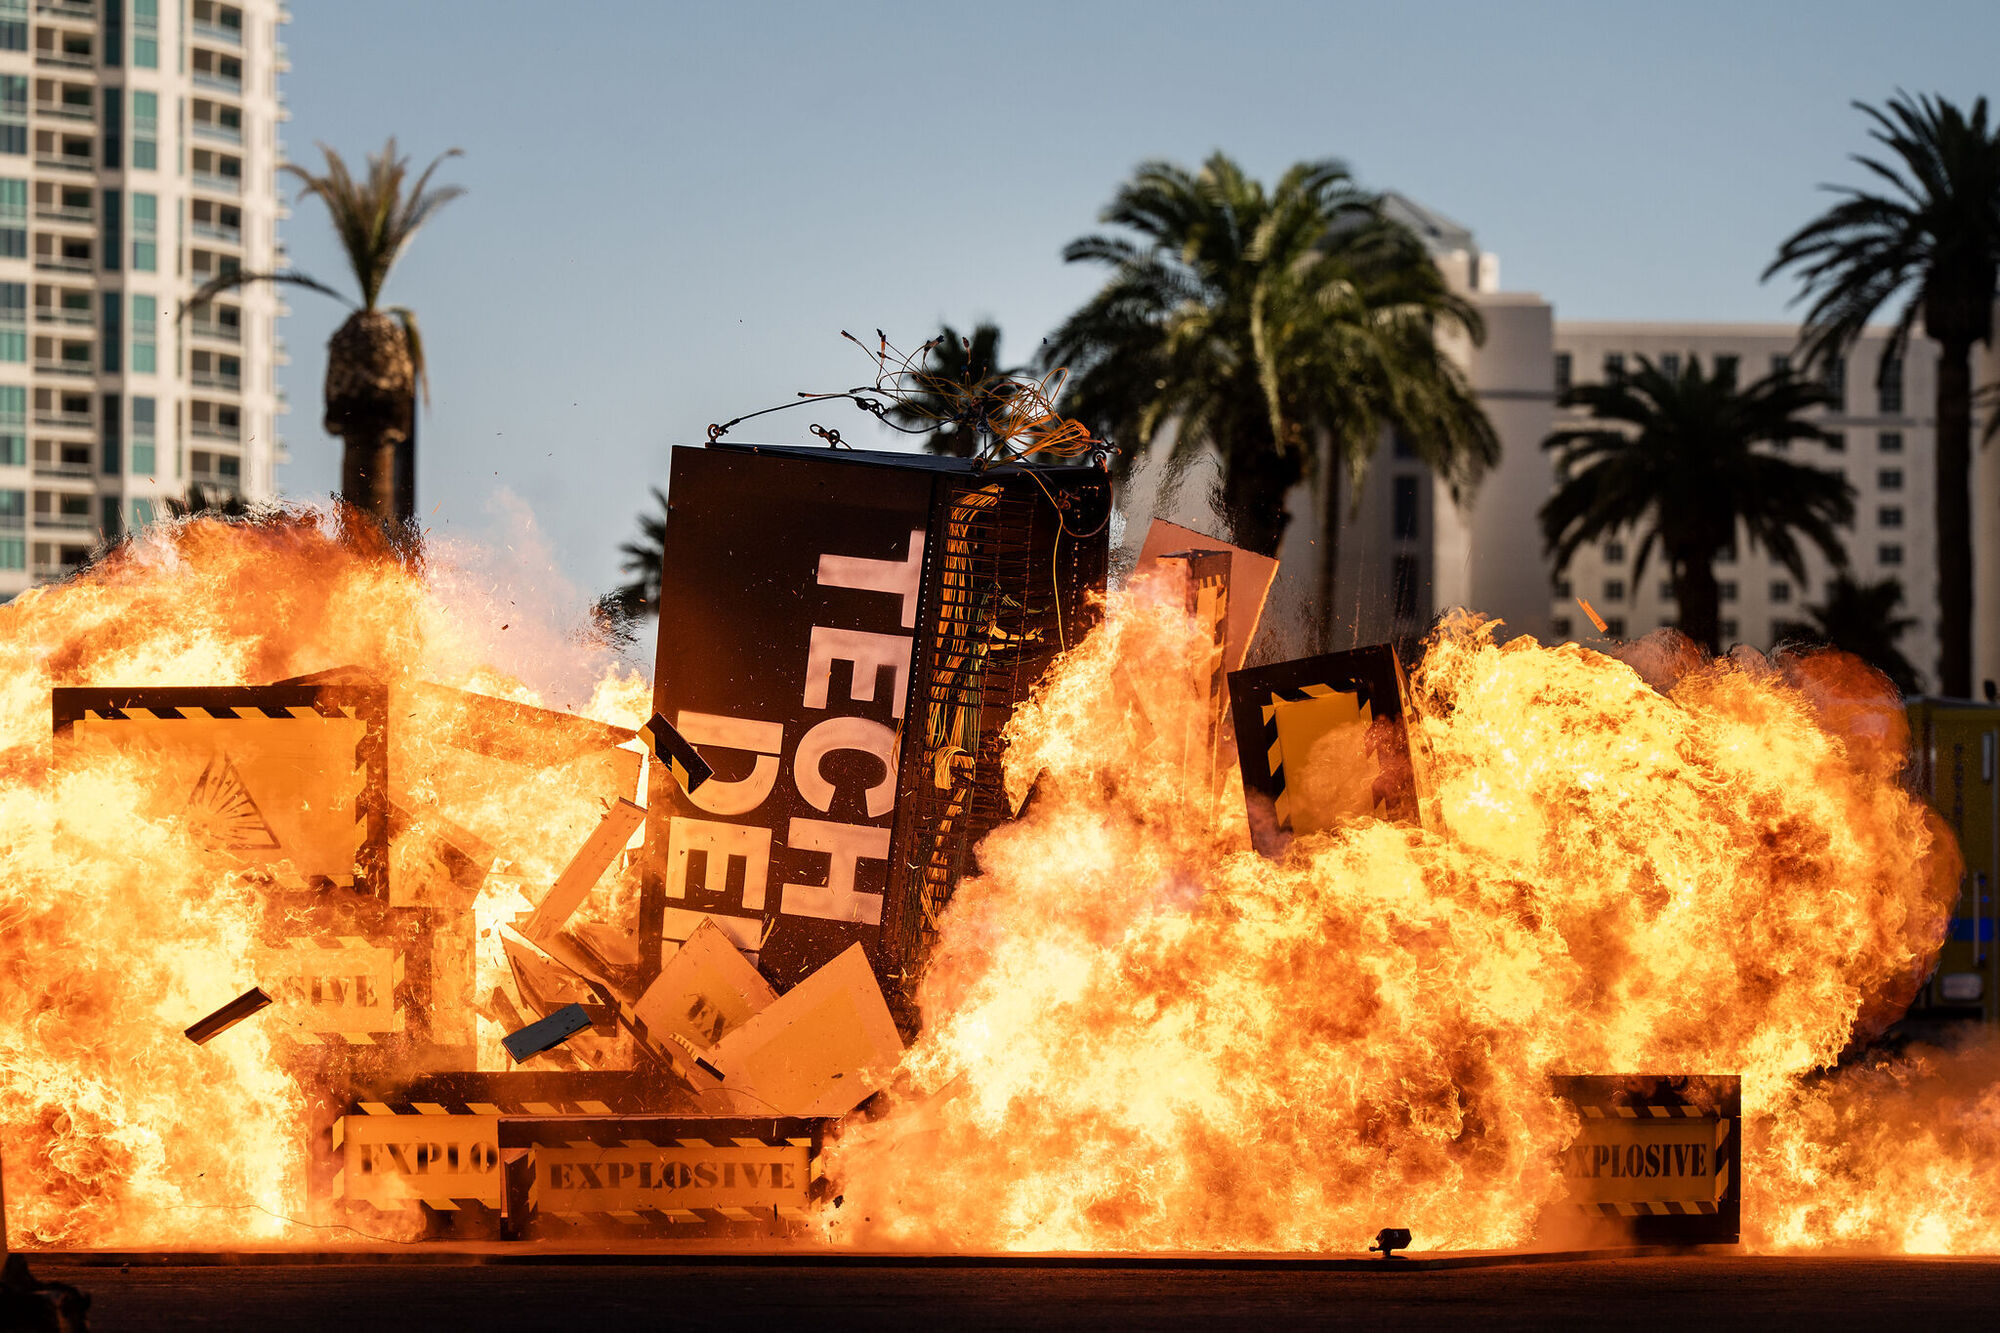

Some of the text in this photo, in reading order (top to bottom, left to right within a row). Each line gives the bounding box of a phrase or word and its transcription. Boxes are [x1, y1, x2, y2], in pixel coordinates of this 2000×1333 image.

[780, 530, 926, 926] TECH
[549, 1161, 795, 1190] EXPLOSIVE
[1565, 1143, 1707, 1178] XPLOSIVE
